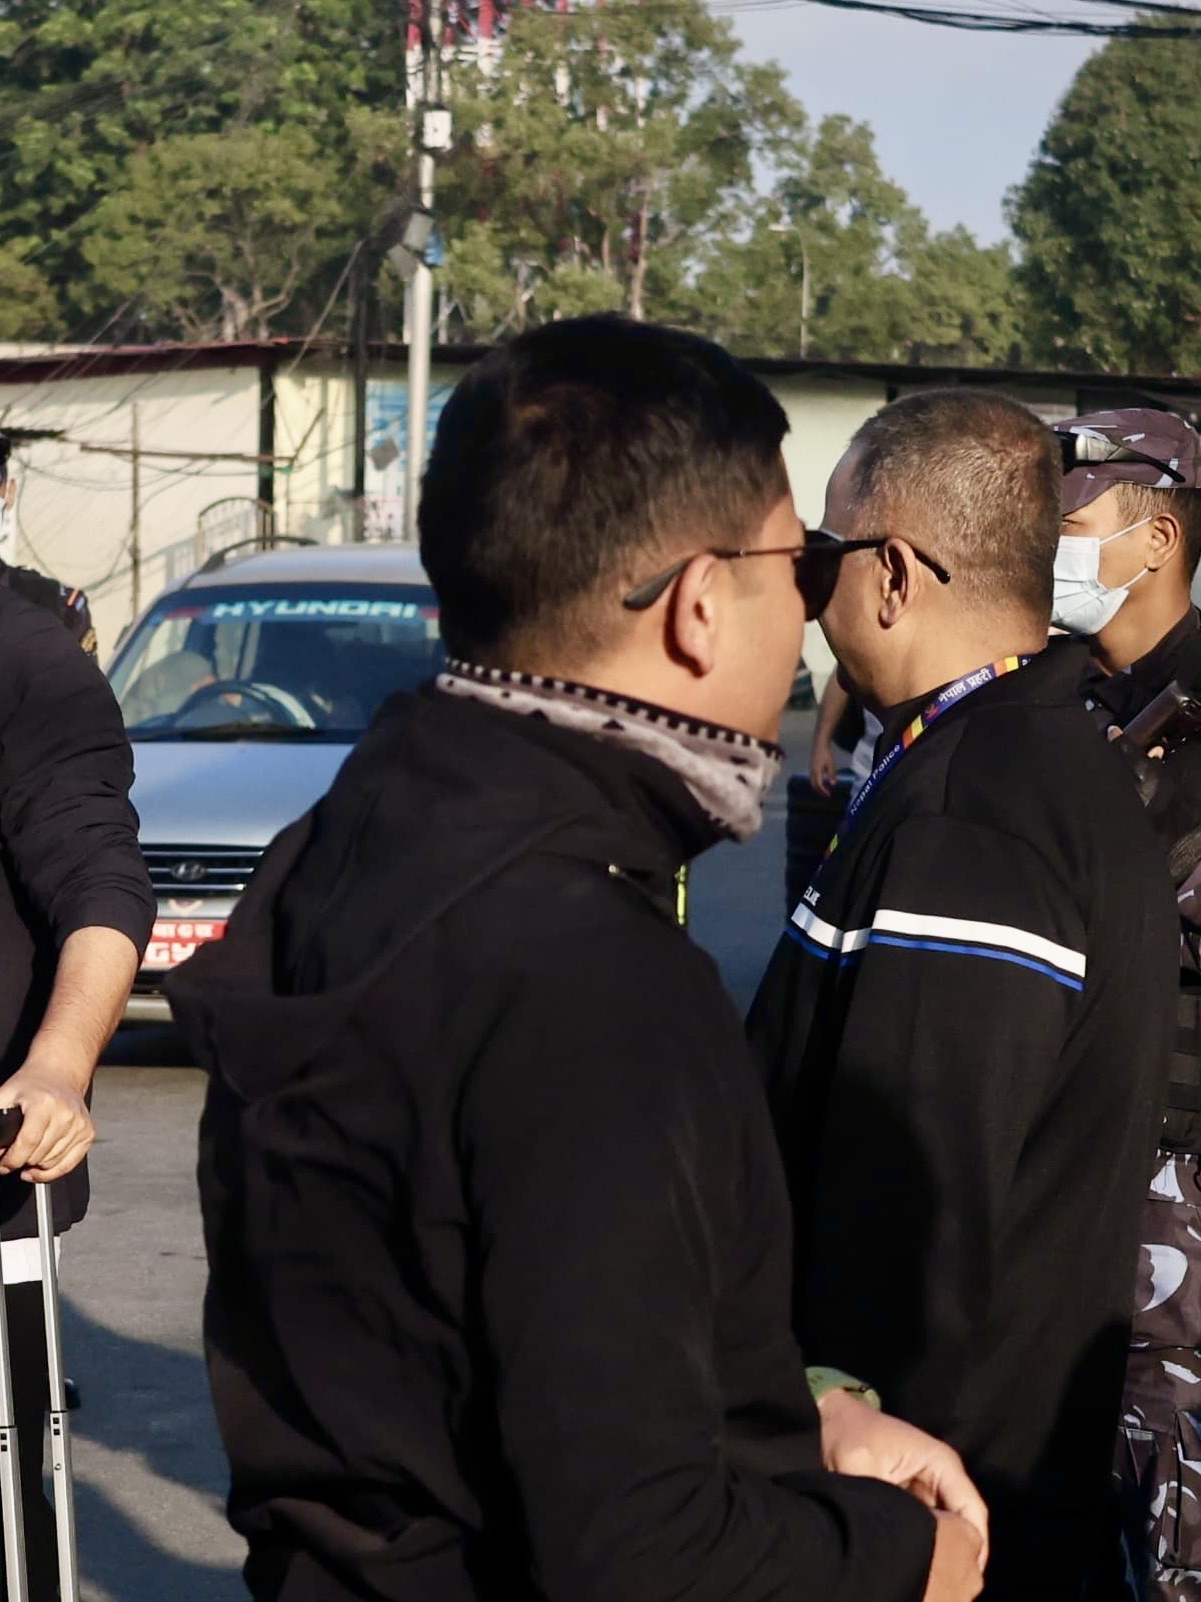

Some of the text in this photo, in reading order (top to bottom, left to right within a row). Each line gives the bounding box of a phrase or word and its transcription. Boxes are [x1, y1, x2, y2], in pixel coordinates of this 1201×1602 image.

[213, 600, 418, 618] HYUNDAI
[850, 744, 900, 816] Nepal Police
